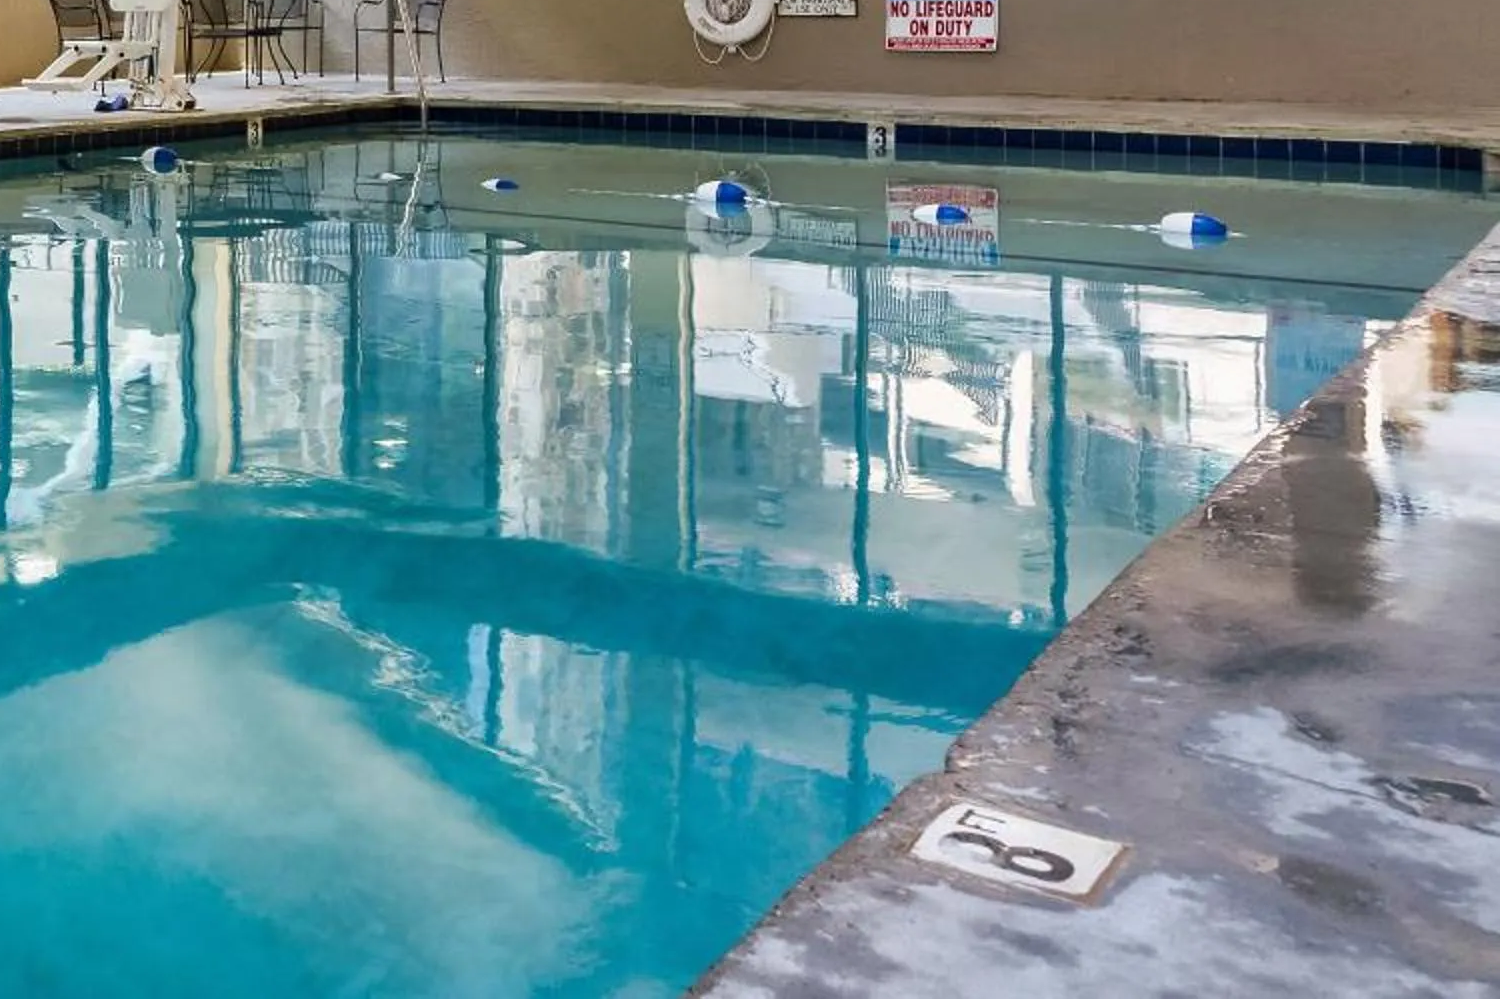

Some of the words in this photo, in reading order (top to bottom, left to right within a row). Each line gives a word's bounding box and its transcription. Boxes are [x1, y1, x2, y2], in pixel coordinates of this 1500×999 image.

[891, 1, 909, 18] NO
[916, 1, 994, 18] LIFEGUARD
[910, 20, 929, 36] ON
[936, 20, 973, 36] DUTY
[875, 126, 887, 149] 3
